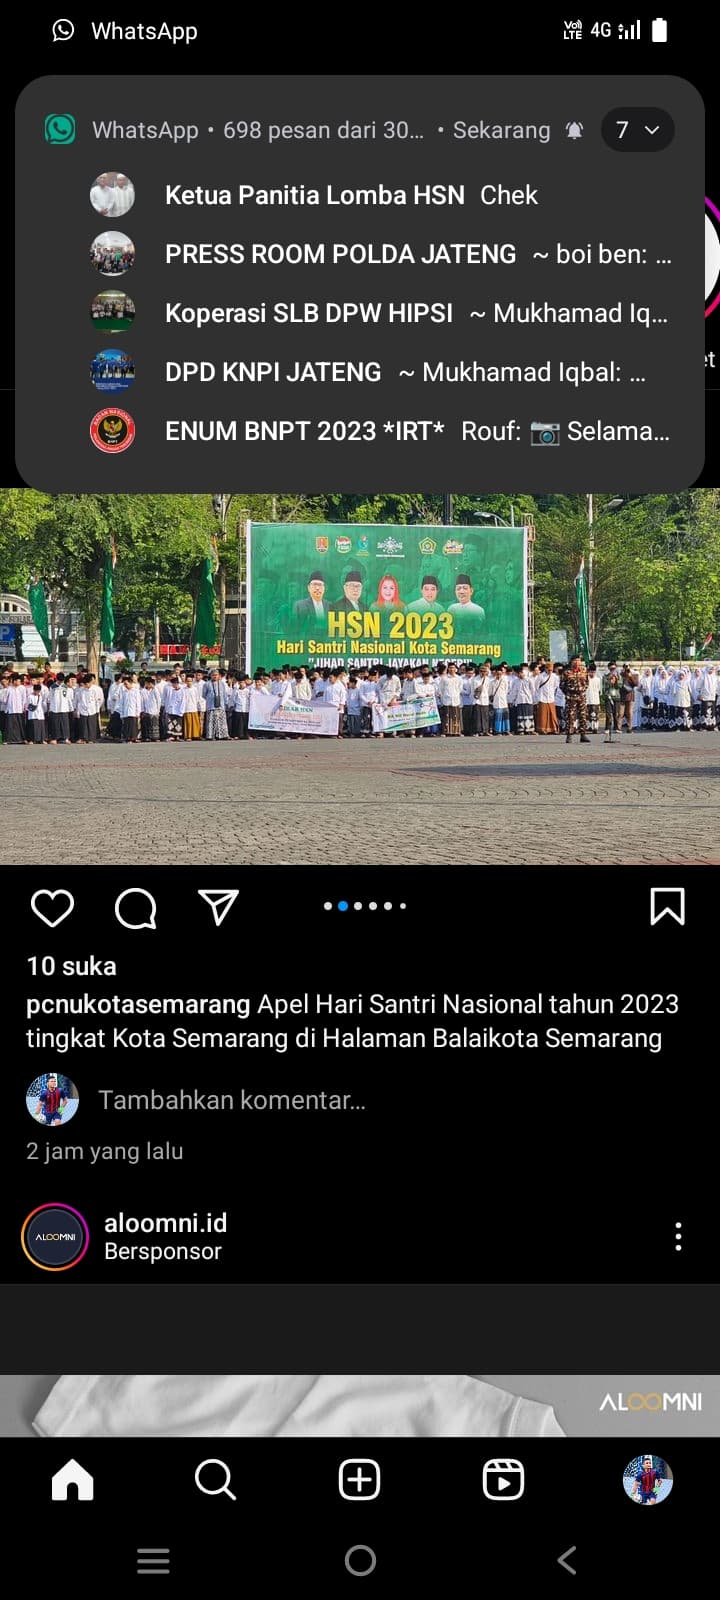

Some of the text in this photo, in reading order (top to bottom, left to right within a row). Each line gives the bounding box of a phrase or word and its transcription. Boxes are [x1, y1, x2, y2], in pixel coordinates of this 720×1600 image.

[91, 21, 198, 45] WhatsApp
[590, 22, 612, 38] 4G
[92, 120, 199, 144] WhatsApp
[223, 120, 262, 140] 698
[268, 124, 331, 144] pesan
[337, 119, 376, 140] dari
[453, 120, 551, 144] Sekarang
[615, 120, 629, 139] 7
[166, 183, 539, 206] Ketua Panitia Lomba HSN Chek
[165, 243, 245, 265] PRESS
[252, 243, 325, 265] ROOM
[333, 243, 416, 265] POLDA
[420, 243, 516, 265] JATENG
[556, 242, 592, 265] boi
[598, 242, 647, 265] ben:
[166, 302, 266, 329] Koperasi
[273, 302, 319, 324] SLB
[326, 302, 382, 323] DPW
[388, 302, 453, 324] HIPSI
[494, 301, 622, 324] Mukhamad
[165, 361, 216, 382] DPD
[223, 361, 280, 382] KNPI
[285, 361, 381, 383] JATENG
[423, 360, 551, 383] Mukhamad
[559, 360, 621, 388] Iqbal:
[166, 420, 237, 441] ENUM
[244, 420, 312, 441] BNPT
[317, 420, 377, 442] 2023
[462, 419, 521, 442] Rouf:
[328, 611, 454, 640] HSN 2023
[276, 640, 502, 657] Hari Santri Nasional Kota Semarang
[27, 954, 117, 976] 10 suka
[26, 992, 679, 1020] pcnukotasemarang Apel Hari Santri Nasional tahun 2023
[26, 1026, 662, 1054] tingkat Kota Semarang di Halaman Balaikota Semarang
[98, 1089, 234, 1110] Tambahkan
[26, 1141, 183, 1165] 2 jam yang lalu
[104, 1211, 227, 1233] aloomni.id
[35, 1233, 76, 1241] ALOOMNI
[105, 1241, 223, 1265] Bersponsor
[599, 1391, 702, 1411] ALOOMNI
